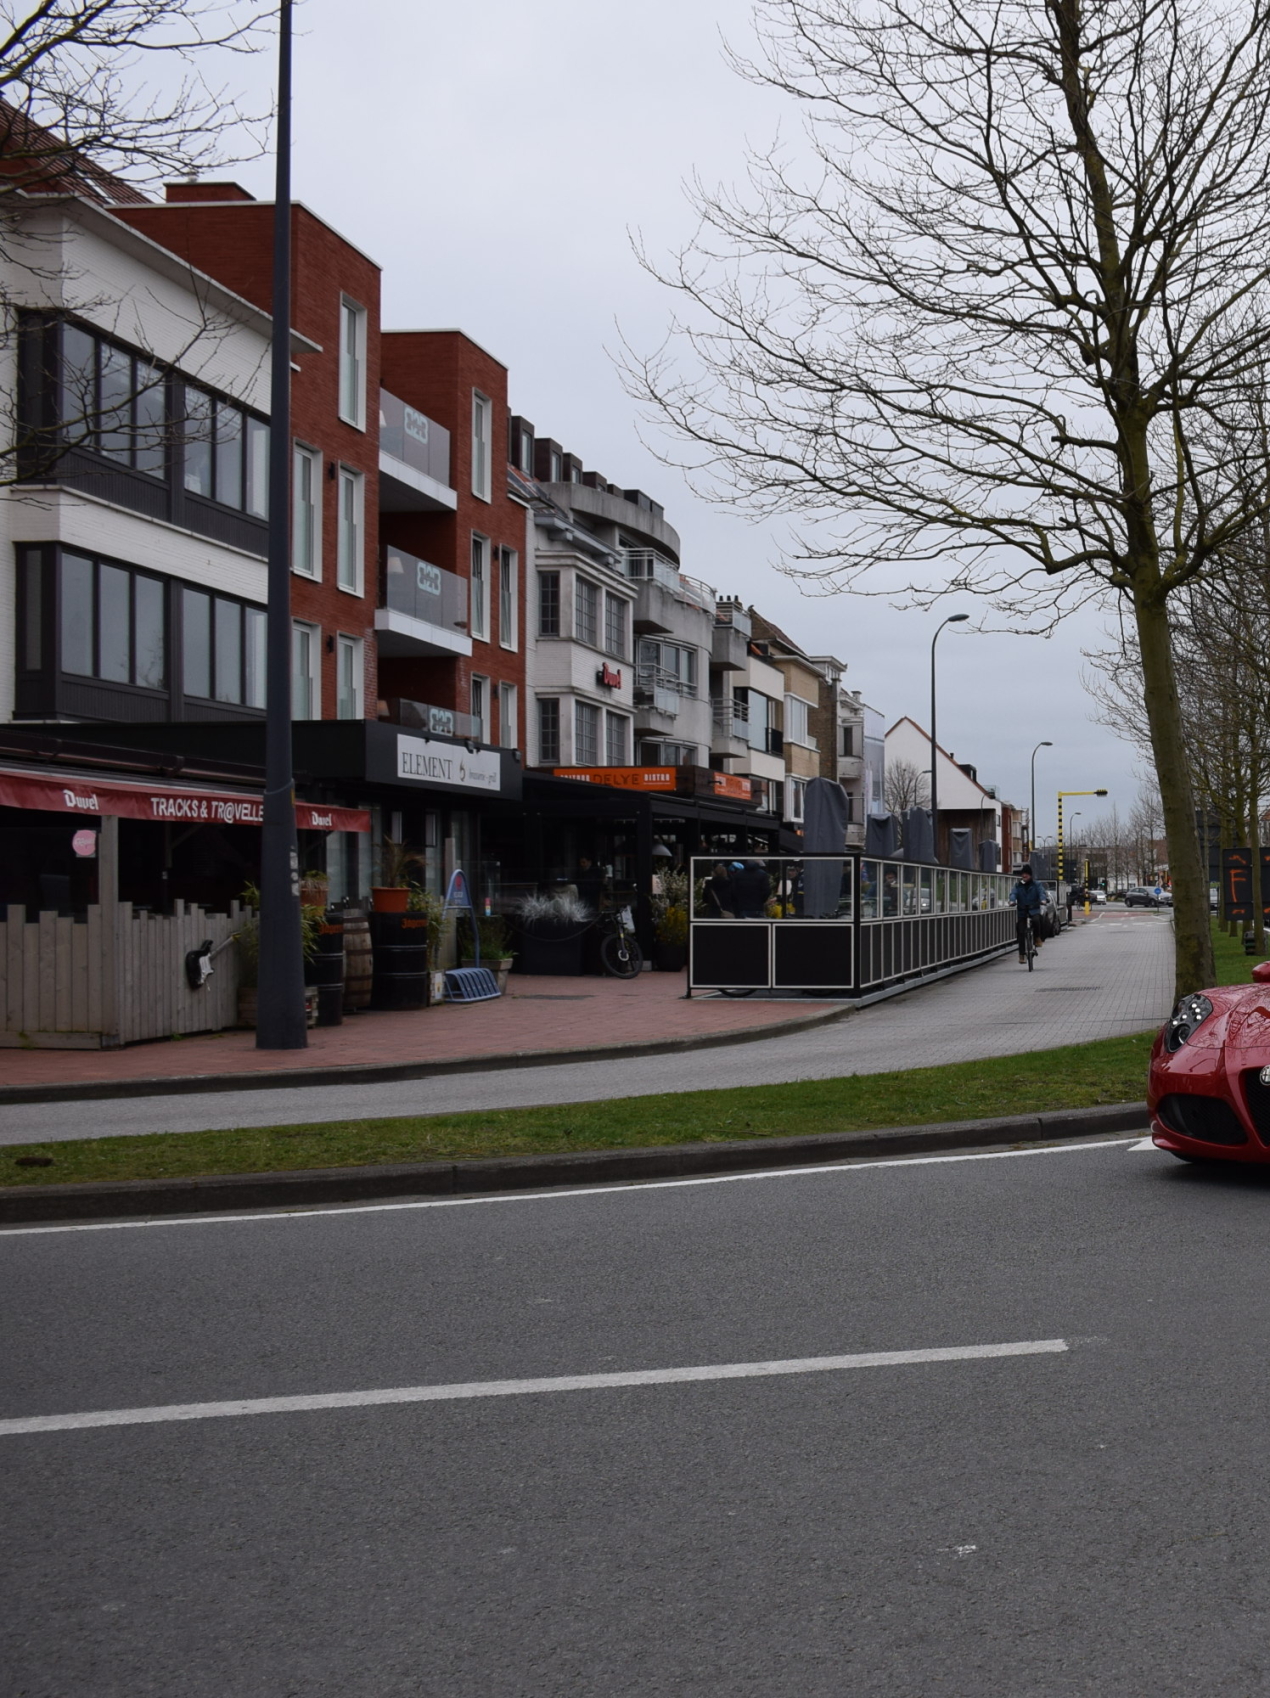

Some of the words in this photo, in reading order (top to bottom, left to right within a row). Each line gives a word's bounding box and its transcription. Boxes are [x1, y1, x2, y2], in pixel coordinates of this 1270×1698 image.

[402, 752, 453, 780] ELEMENT
[63, 789, 99, 811] Duvel
[151, 797, 199, 818] TRACKS
[200, 802, 208, 818] &
[211, 800, 264, 824] TR@VELLE
